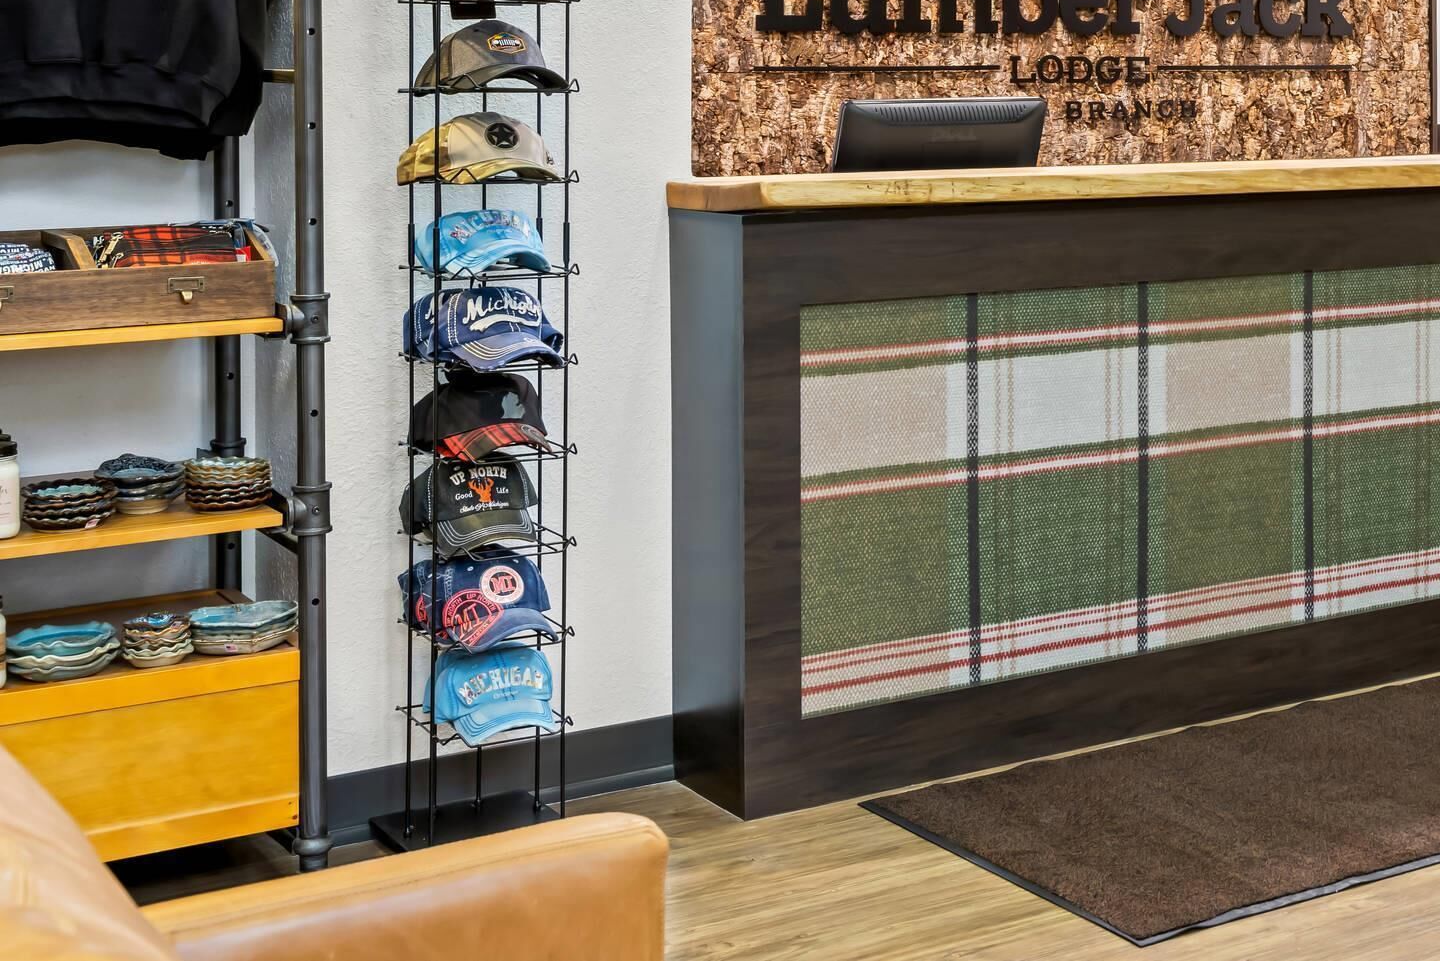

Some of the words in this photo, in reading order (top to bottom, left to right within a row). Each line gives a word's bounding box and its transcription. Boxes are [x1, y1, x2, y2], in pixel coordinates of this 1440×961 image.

[1009, 55, 1151, 85] LODGE
[1065, 100, 1197, 122] BRANCH
[449, 471, 466, 486] UP
[468, 465, 507, 479] NORTH
[455, 491, 473, 501] Good
[496, 486, 509, 494] Life
[491, 575, 515, 593] MI
